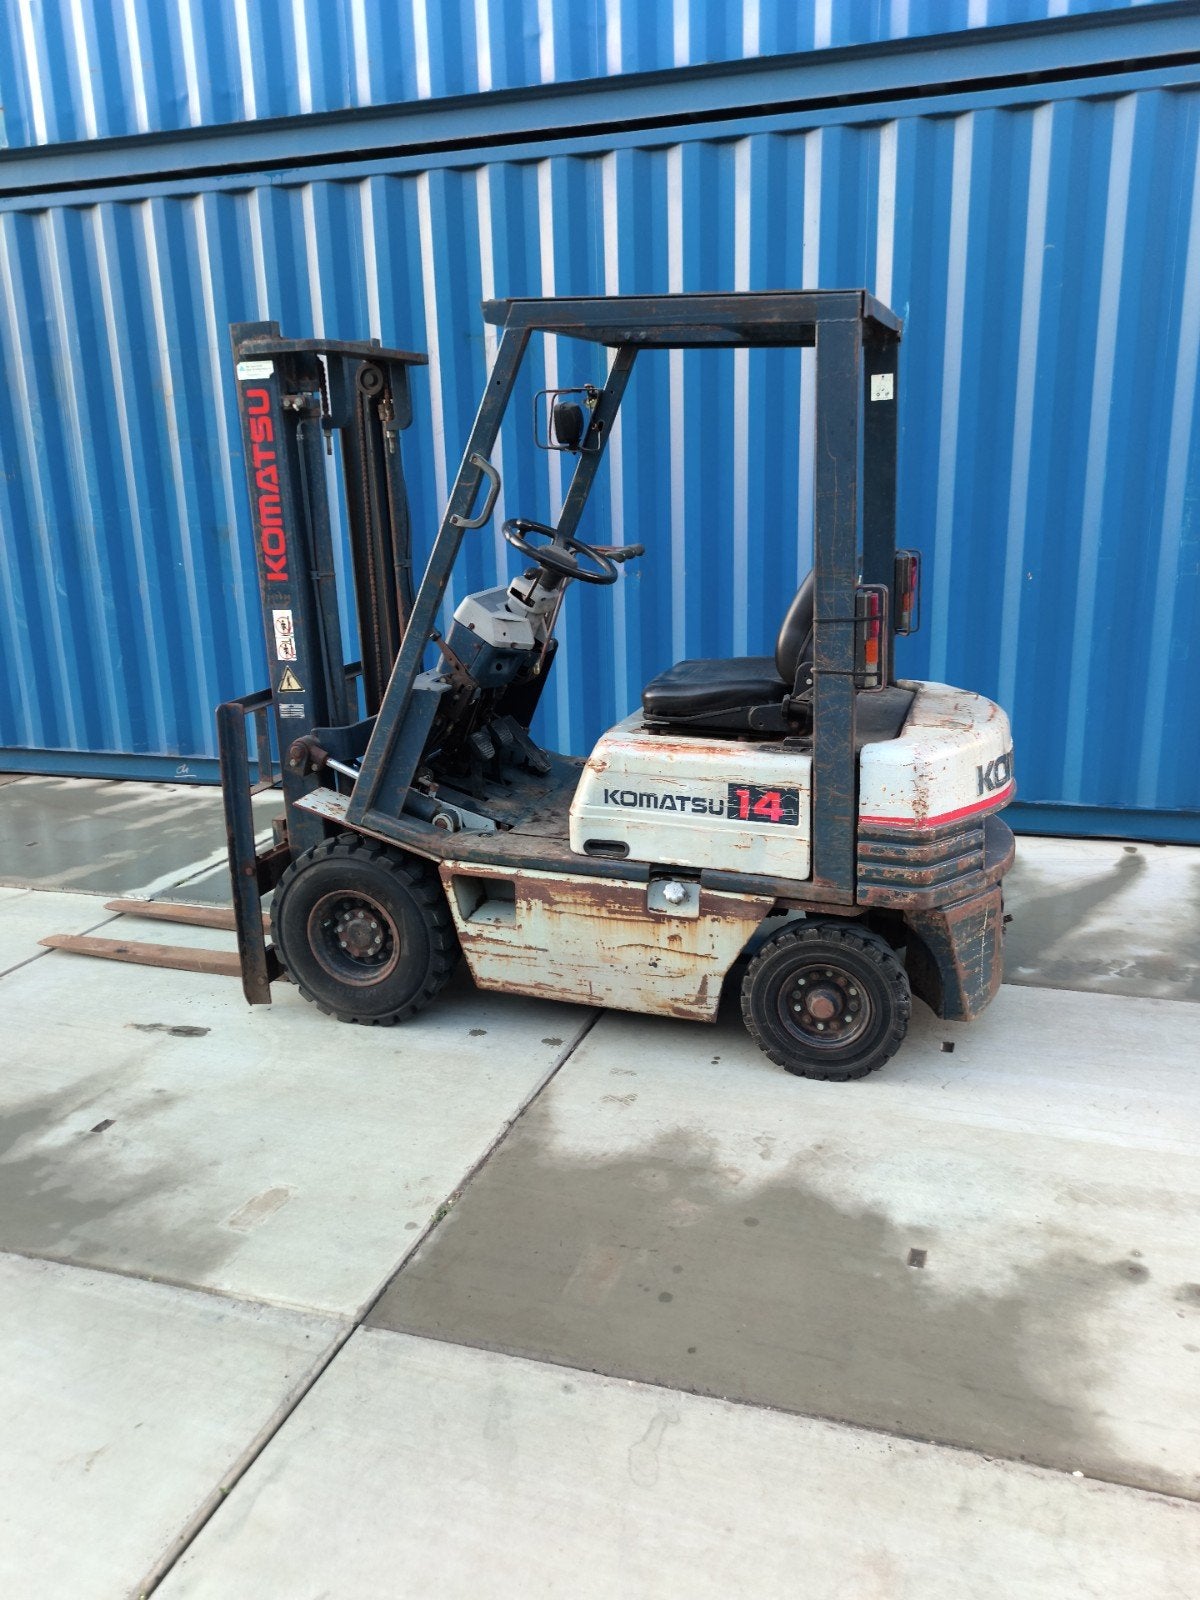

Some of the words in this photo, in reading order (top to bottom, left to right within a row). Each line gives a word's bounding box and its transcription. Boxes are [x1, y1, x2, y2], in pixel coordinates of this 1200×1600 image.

[246, 388, 288, 582] KOMATSU
[976, 750, 1014, 796] KO
[604, 788, 724, 816] KOMATSU
[736, 789, 784, 822] 14
